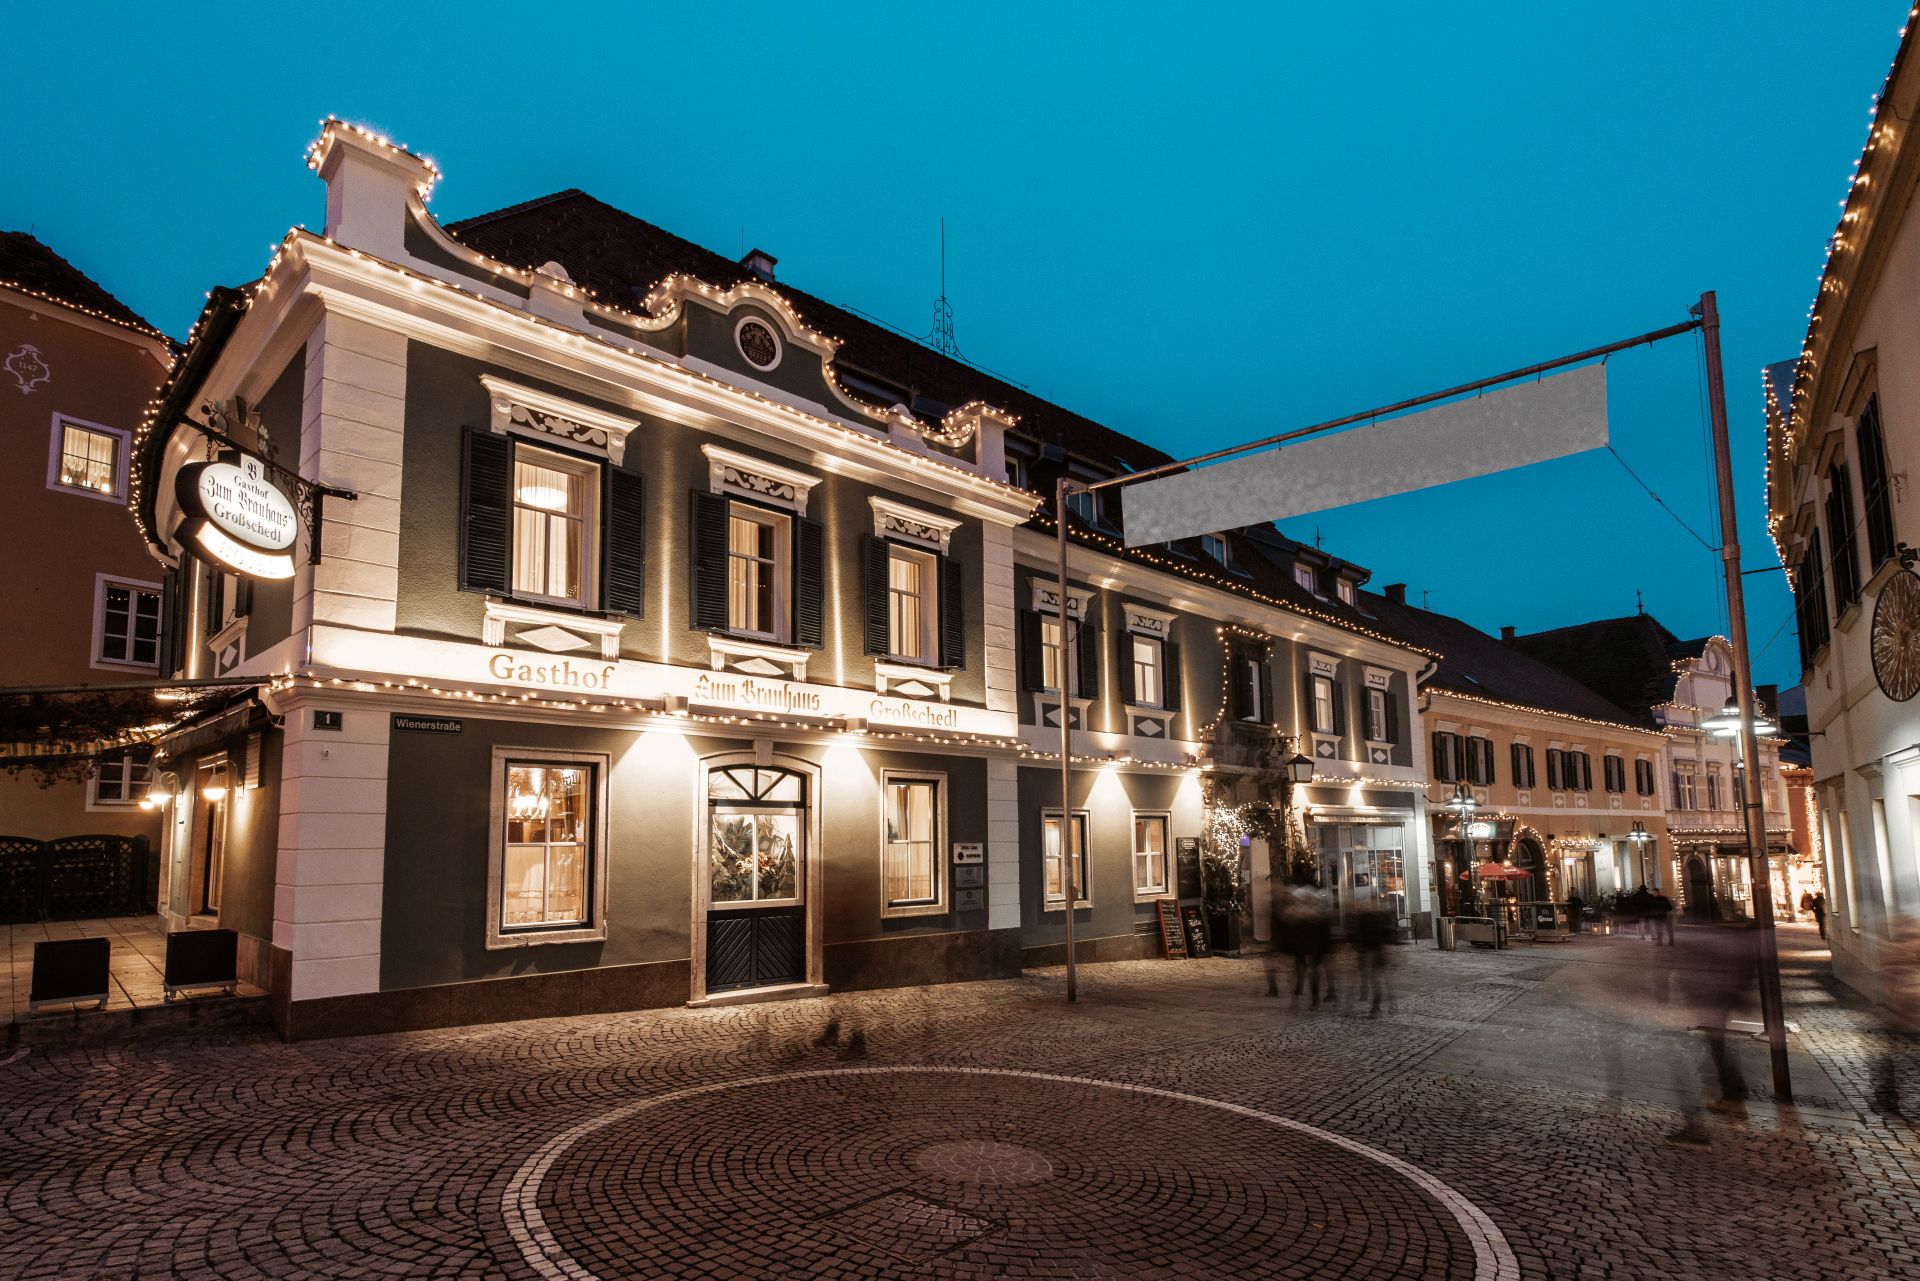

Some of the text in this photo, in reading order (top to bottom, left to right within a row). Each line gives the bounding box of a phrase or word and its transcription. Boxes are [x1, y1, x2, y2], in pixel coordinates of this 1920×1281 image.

[234, 475, 269, 499] Gasthof
[214, 502, 281, 542] Großschedl
[489, 654, 615, 689] Gasthof
[695, 673, 820, 713] Zum Brauhaus
[325, 713, 330, 724] 1
[396, 718, 461, 731] Wienerstraße
[869, 699, 958, 728] Großschedl
